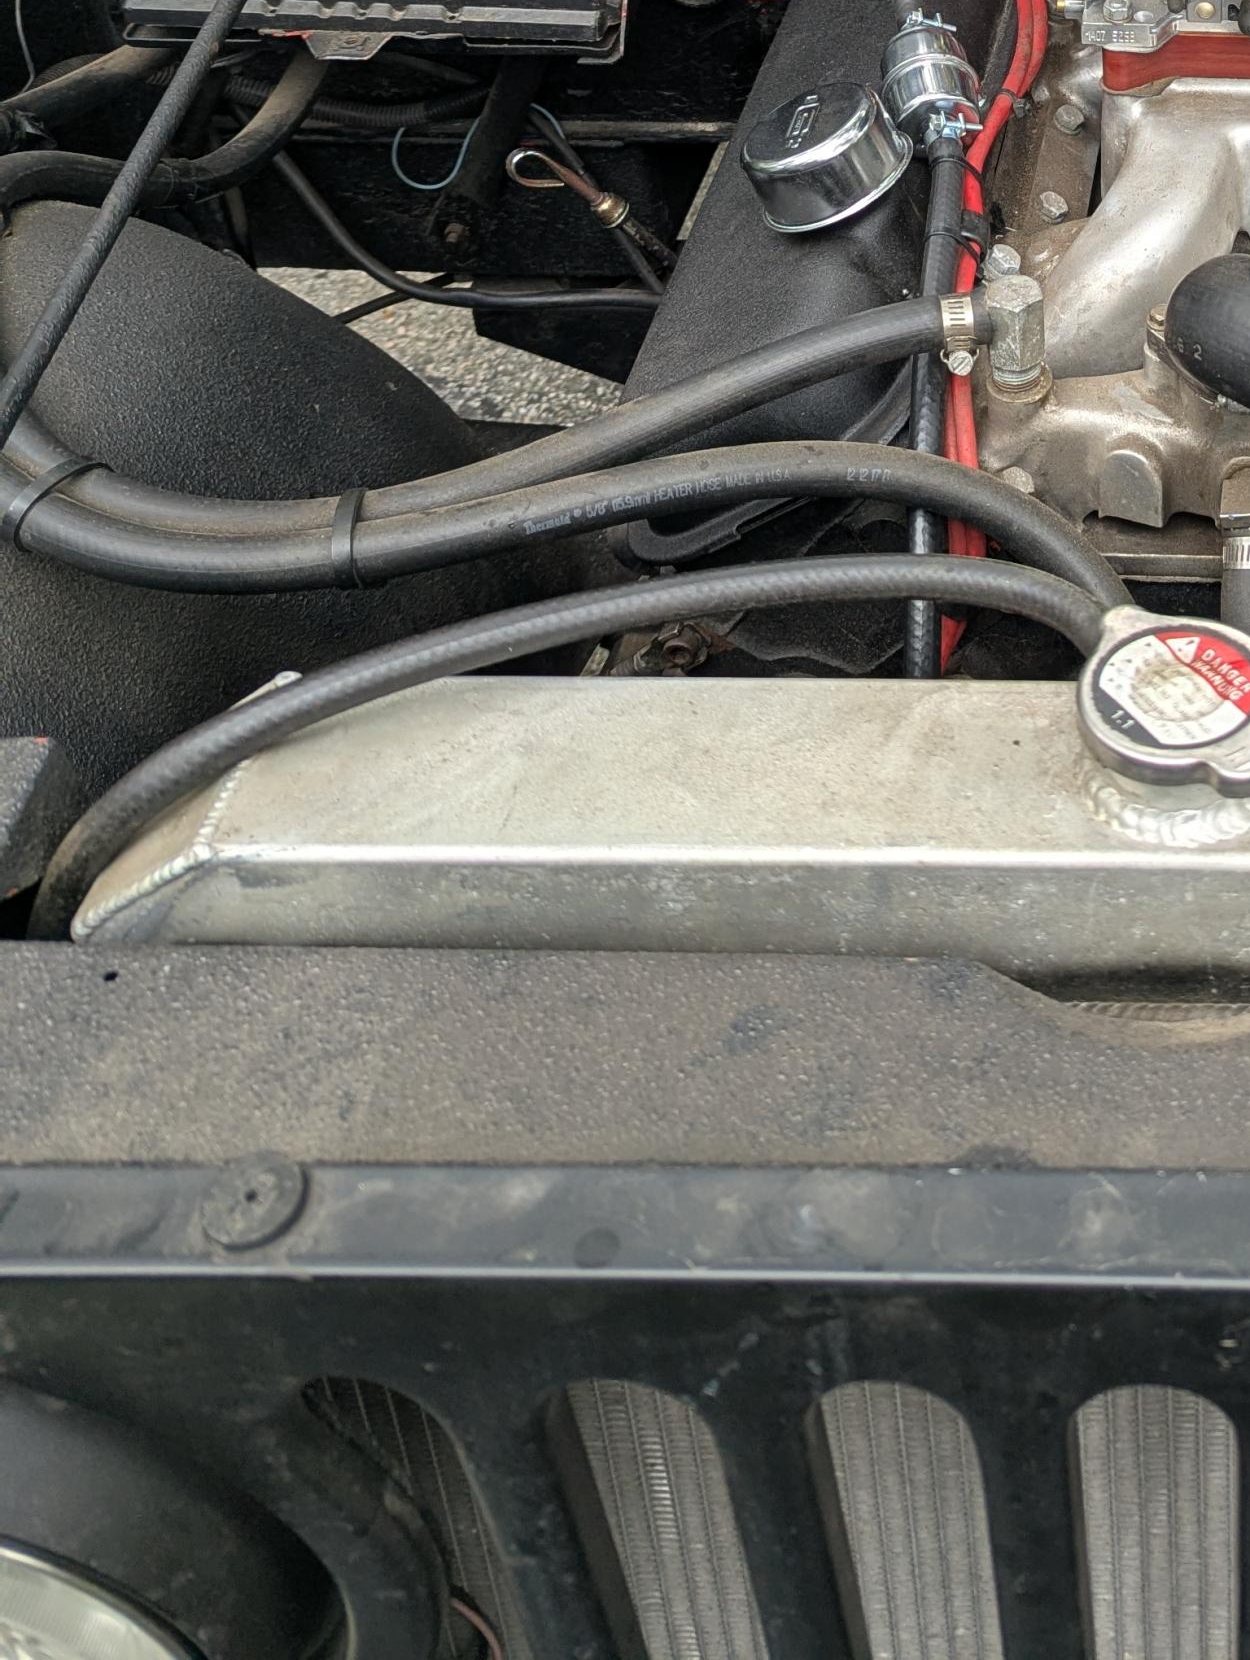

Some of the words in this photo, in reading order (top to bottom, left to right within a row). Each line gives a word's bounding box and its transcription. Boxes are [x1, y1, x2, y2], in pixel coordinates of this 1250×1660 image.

[653, 483, 692, 504] HEATER
[696, 476, 721, 494] HOSE
[725, 474, 751, 488] MADE
[1110, 708, 1136, 730] 1.1
